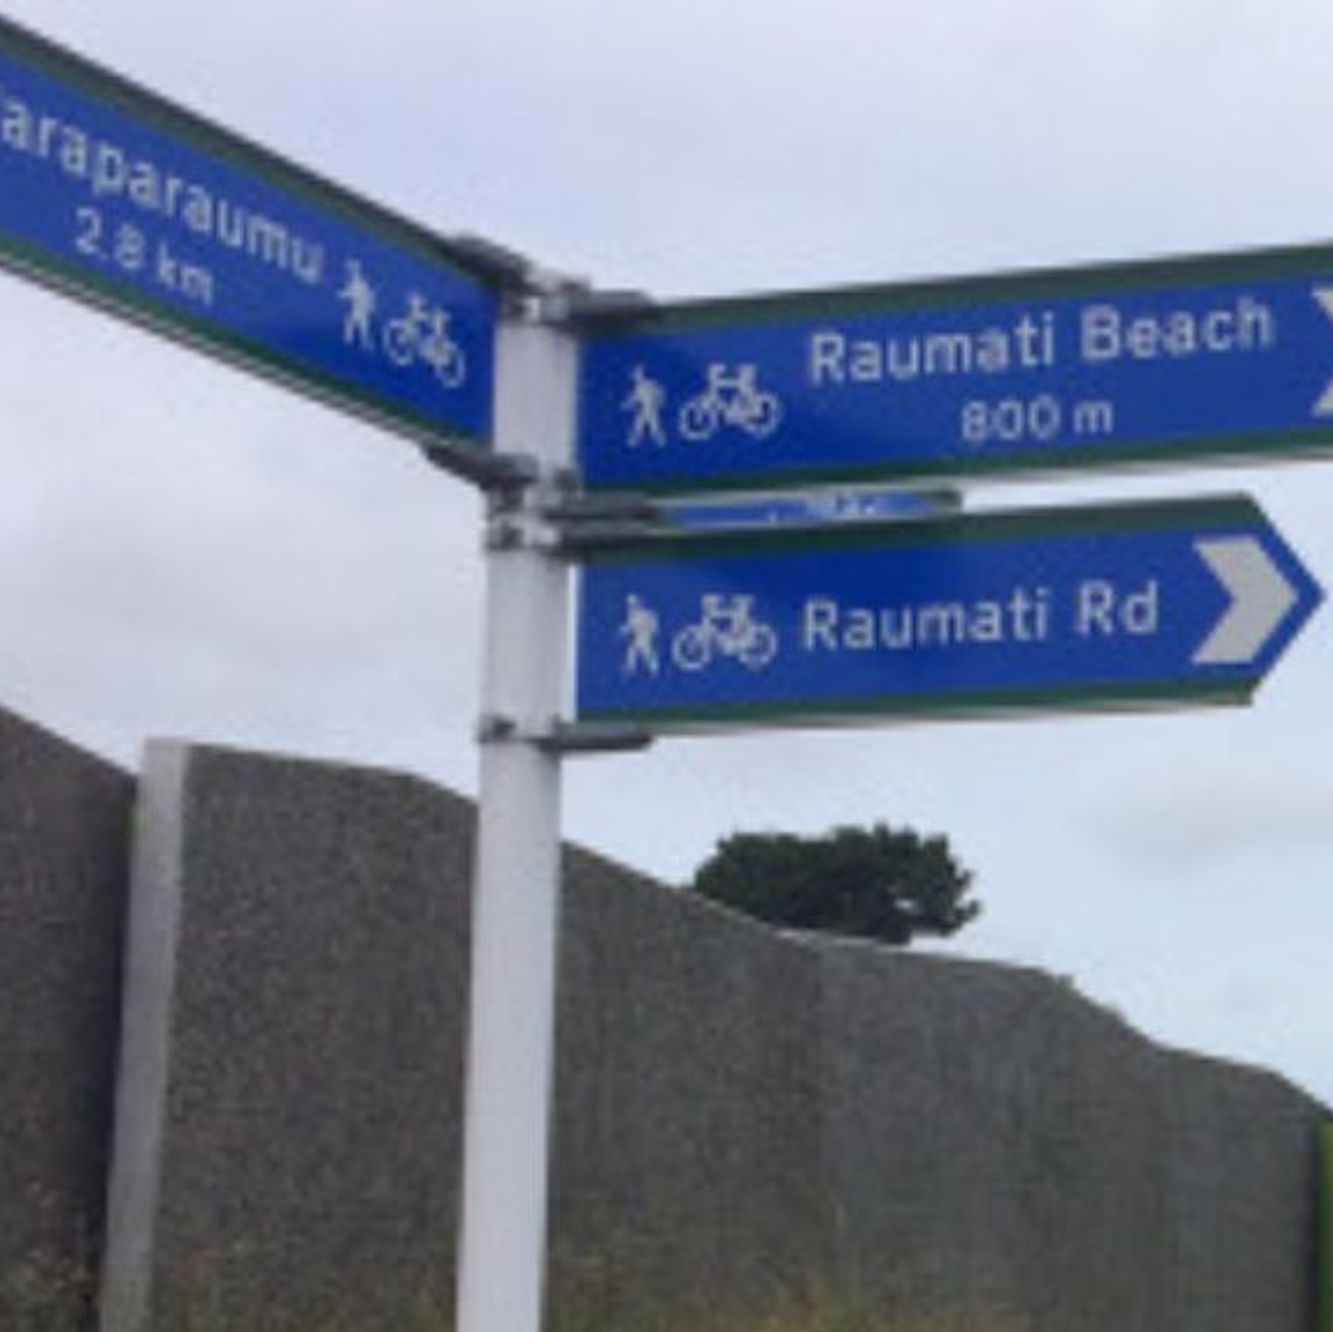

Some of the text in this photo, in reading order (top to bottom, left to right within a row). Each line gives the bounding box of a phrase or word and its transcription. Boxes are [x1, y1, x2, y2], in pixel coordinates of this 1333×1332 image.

[3, 102, 325, 284] araparaumu
[157, 240, 214, 306] km
[810, 298, 1276, 386] Raumati Beach
[960, 395, 1115, 444] 800 m
[803, 579, 1160, 651] Raumati Rd
